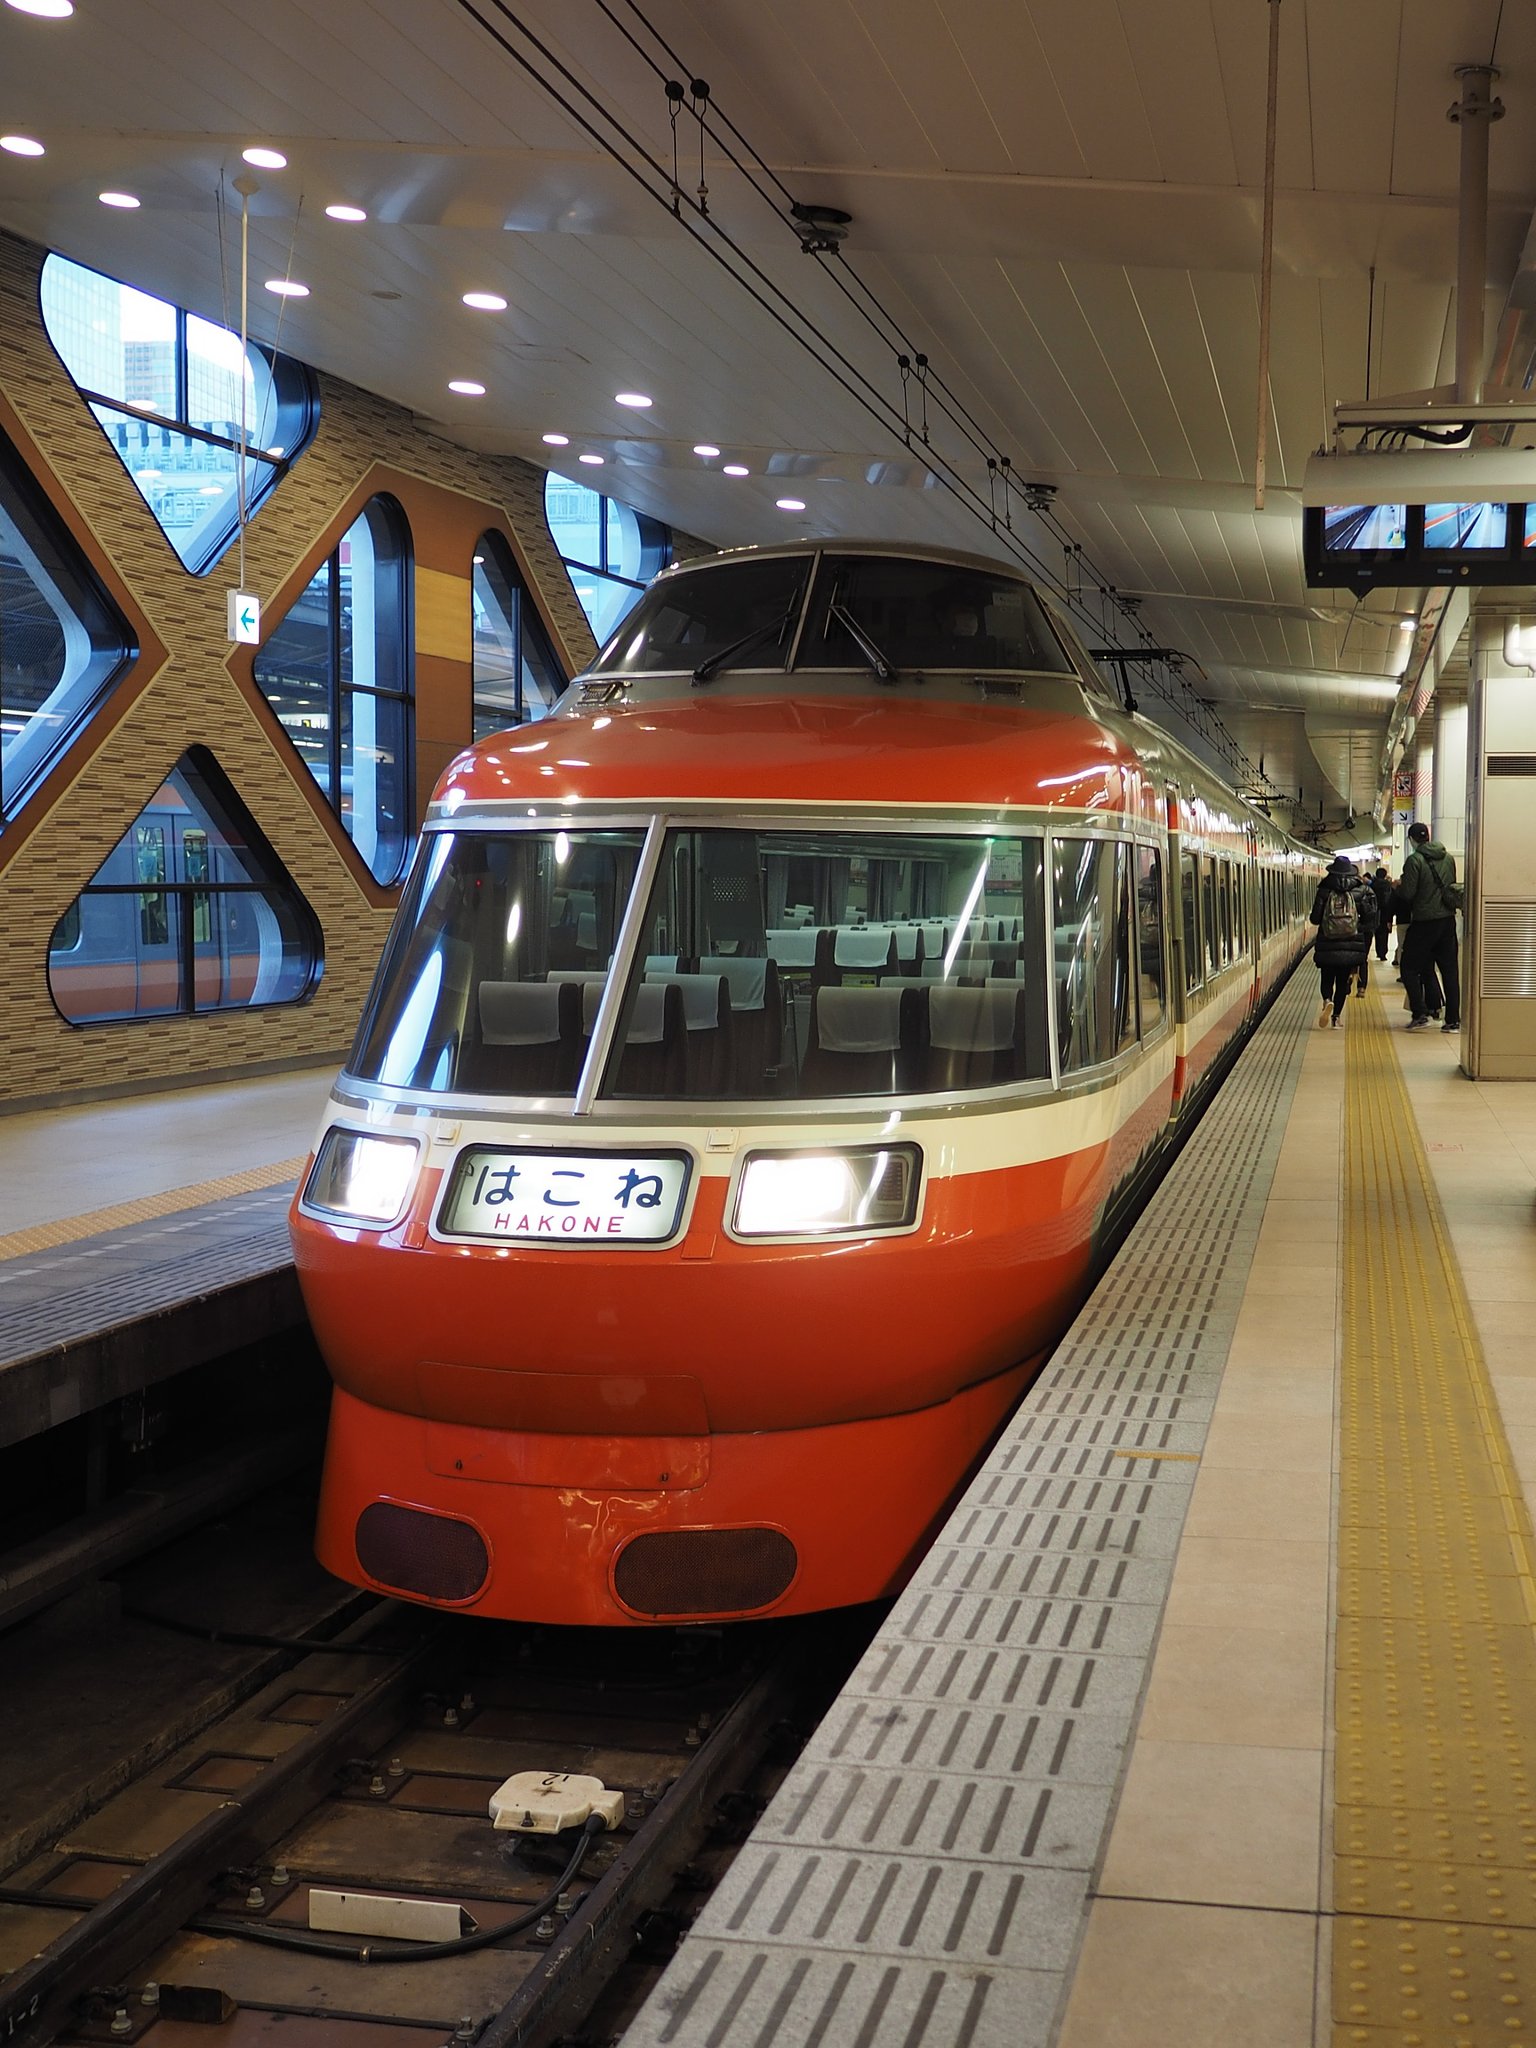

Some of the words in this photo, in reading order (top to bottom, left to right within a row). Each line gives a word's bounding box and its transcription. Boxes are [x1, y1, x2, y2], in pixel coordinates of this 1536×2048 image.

[473, 1165, 663, 1208] はこね
[494, 1213, 625, 1233] HAKONE
